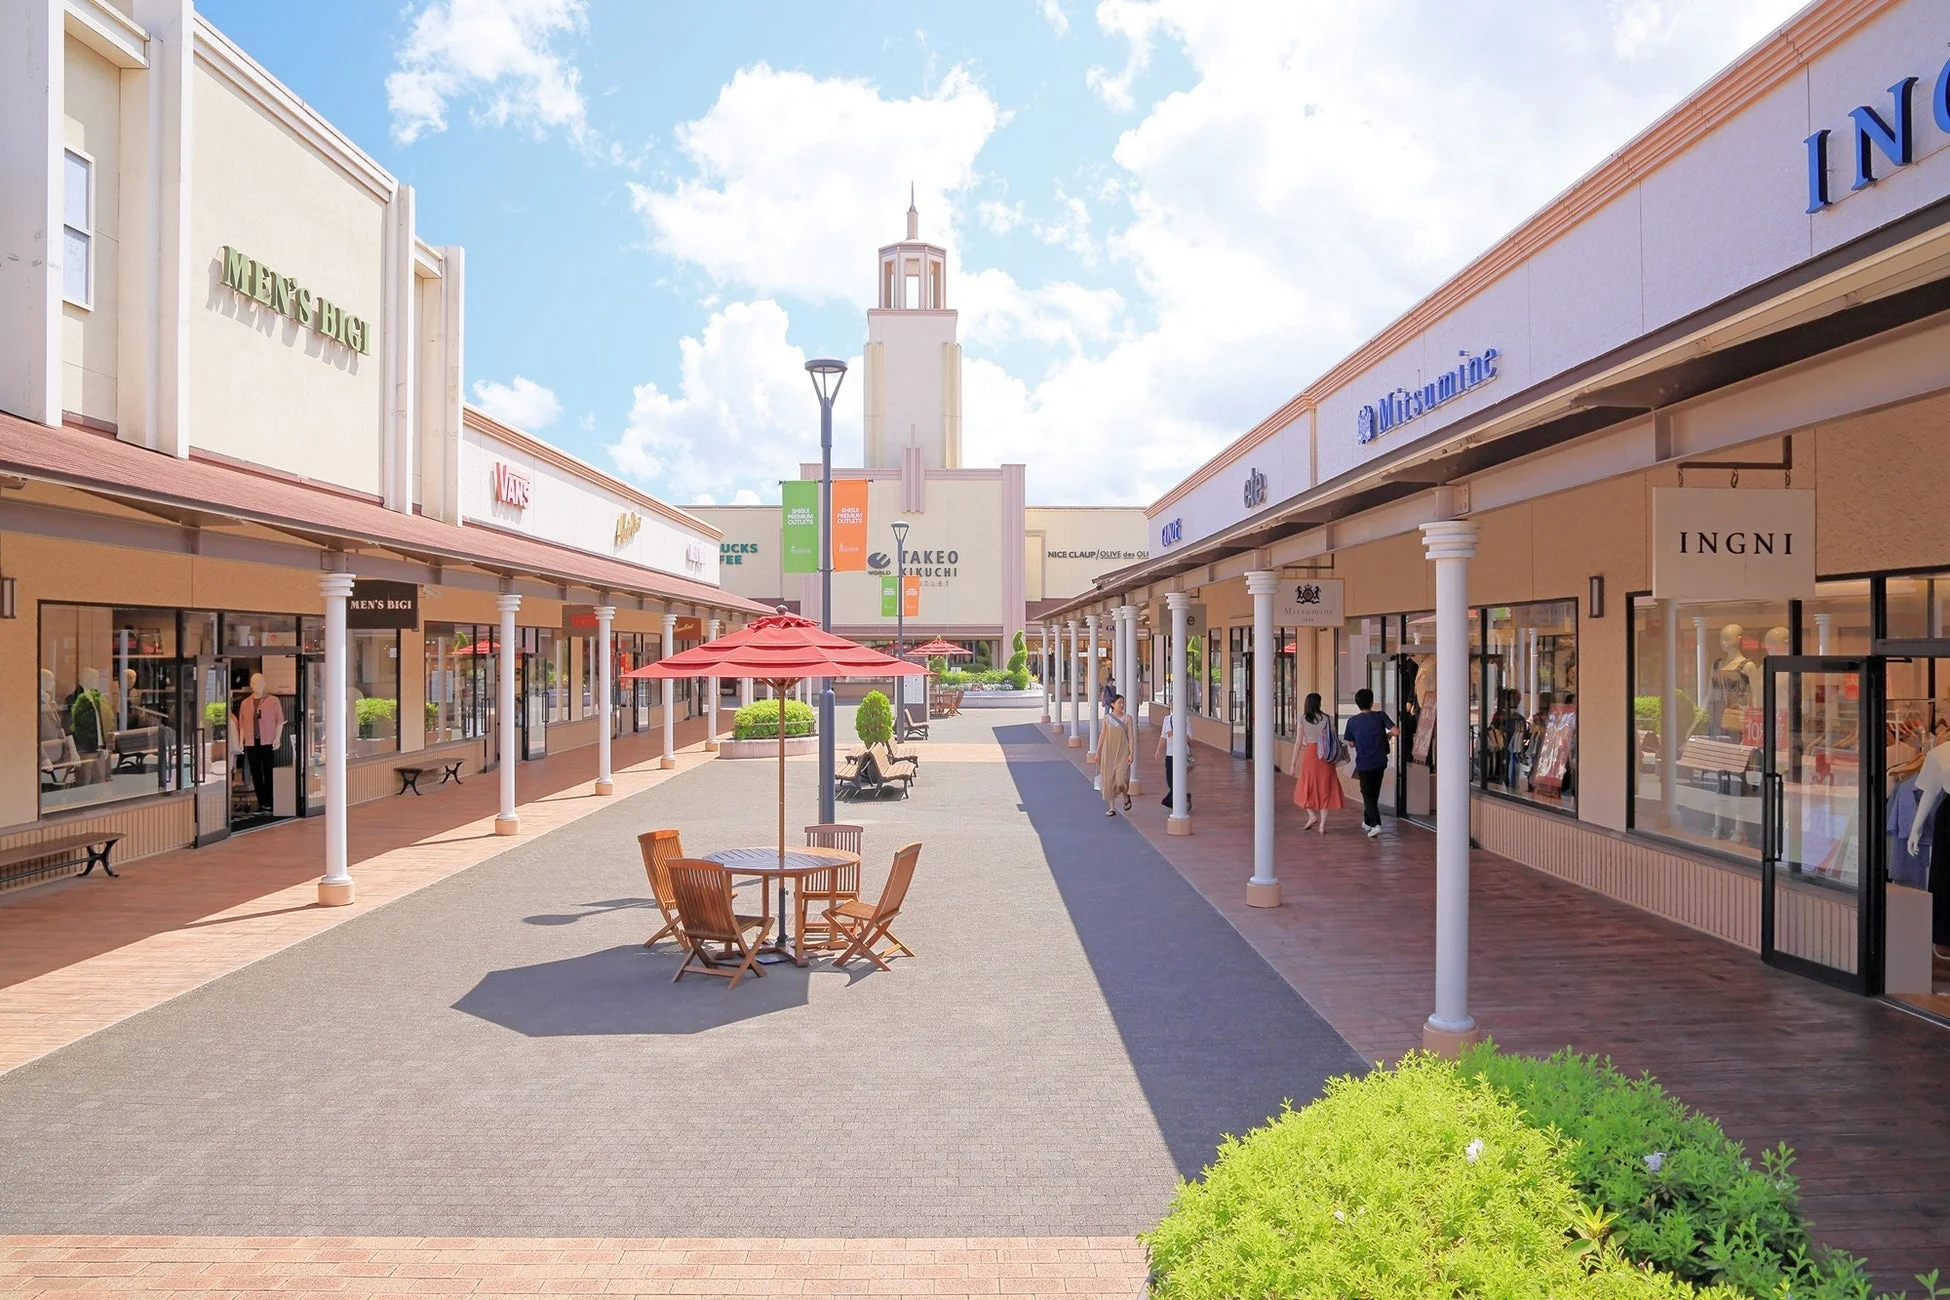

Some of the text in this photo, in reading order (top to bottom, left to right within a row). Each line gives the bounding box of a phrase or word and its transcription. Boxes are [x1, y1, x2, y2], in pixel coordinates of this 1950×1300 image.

[1804, 57, 1950, 214] IN
[220, 246, 371, 356] MEN'S BIGI
[1377, 349, 1499, 434] Mitsumine
[496, 462, 530, 509] VANS
[720, 543, 758, 554] UCKS
[1680, 532, 1792, 554] INGNI
[719, 555, 743, 565] FEE
[902, 550, 959, 564] TAKEO
[1047, 551, 1067, 559] NICE
[1123, 551, 1135, 559] des
[1136, 550, 1149, 559] OLI
[350, 600, 412, 610] MEN'S BIGI
